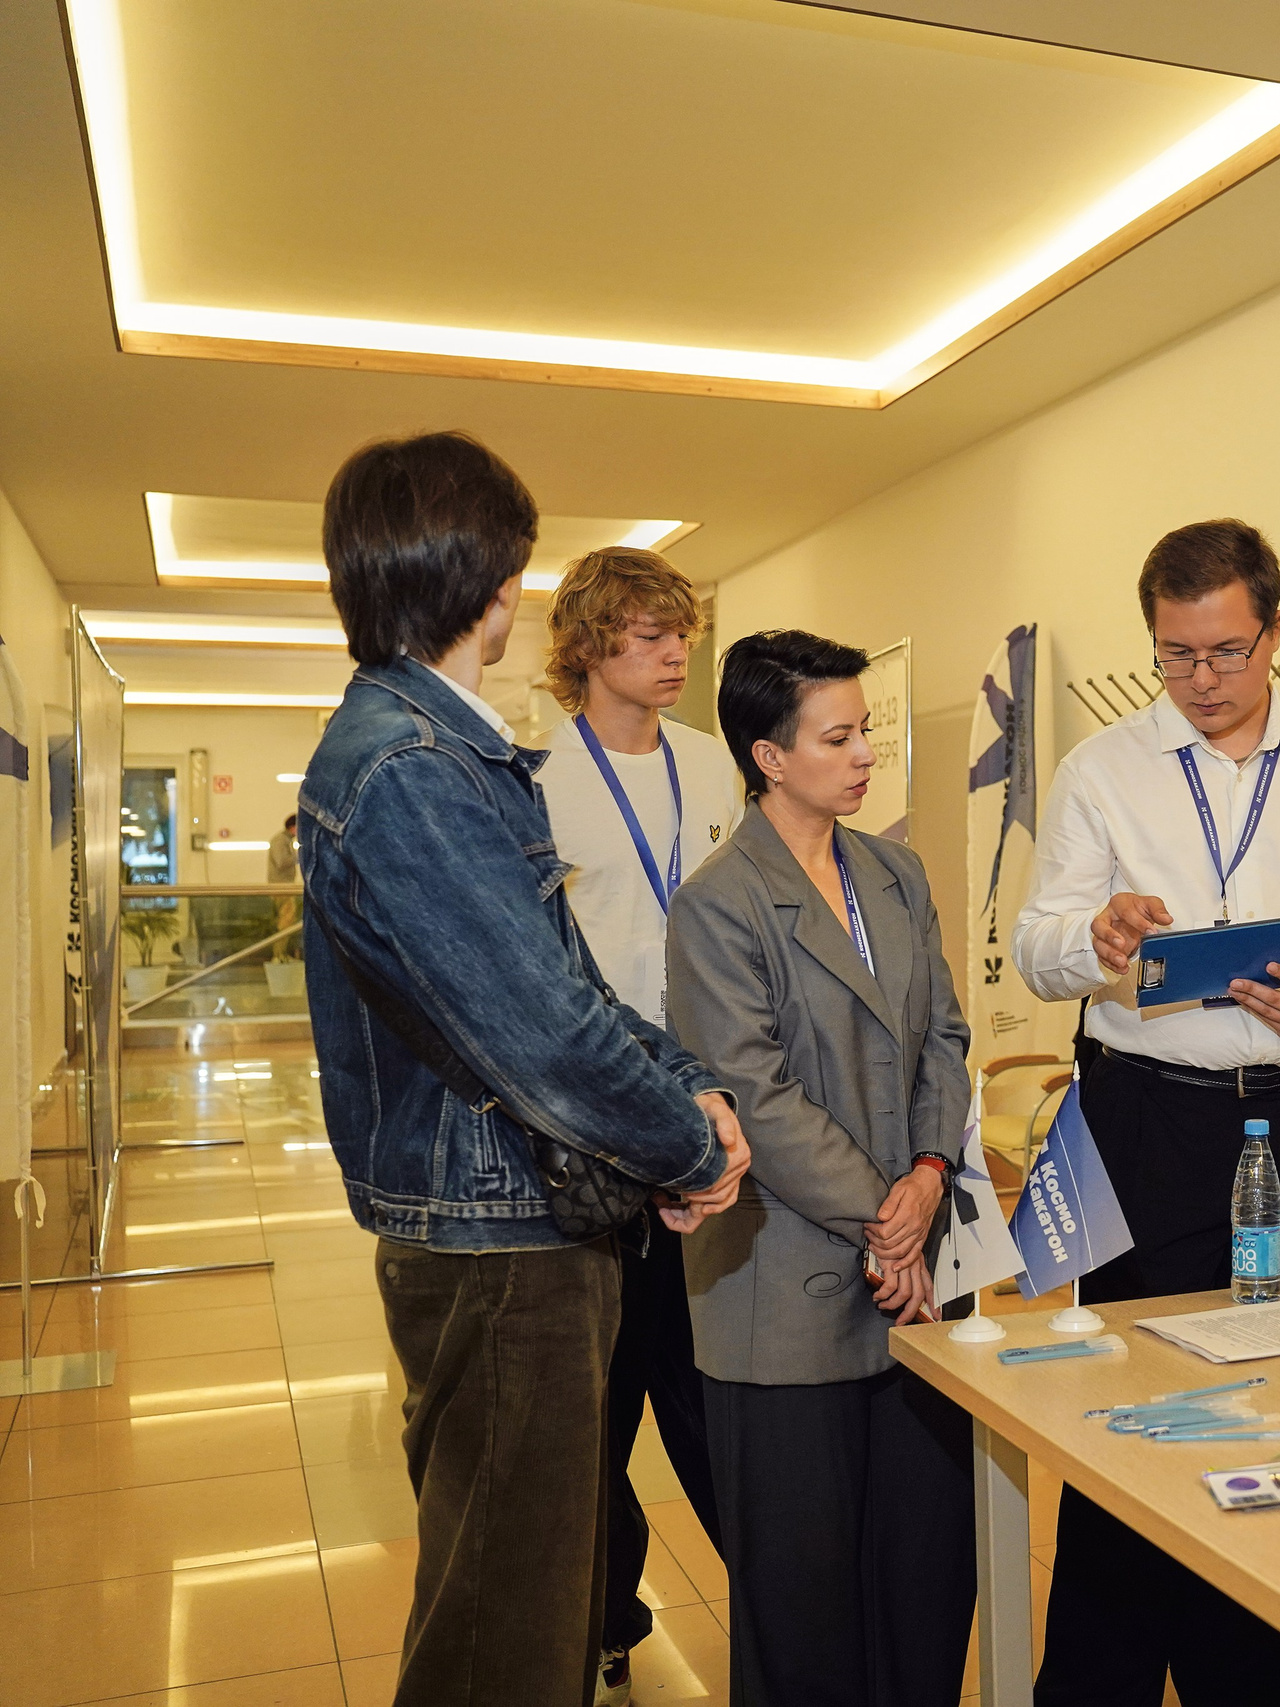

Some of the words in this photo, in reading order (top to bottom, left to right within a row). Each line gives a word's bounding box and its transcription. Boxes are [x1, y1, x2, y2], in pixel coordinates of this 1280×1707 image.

[872, 696, 899, 728] 11-13
[1027, 1170, 1069, 1264] Хакатон
[1039, 1159, 1077, 1236] Космо
